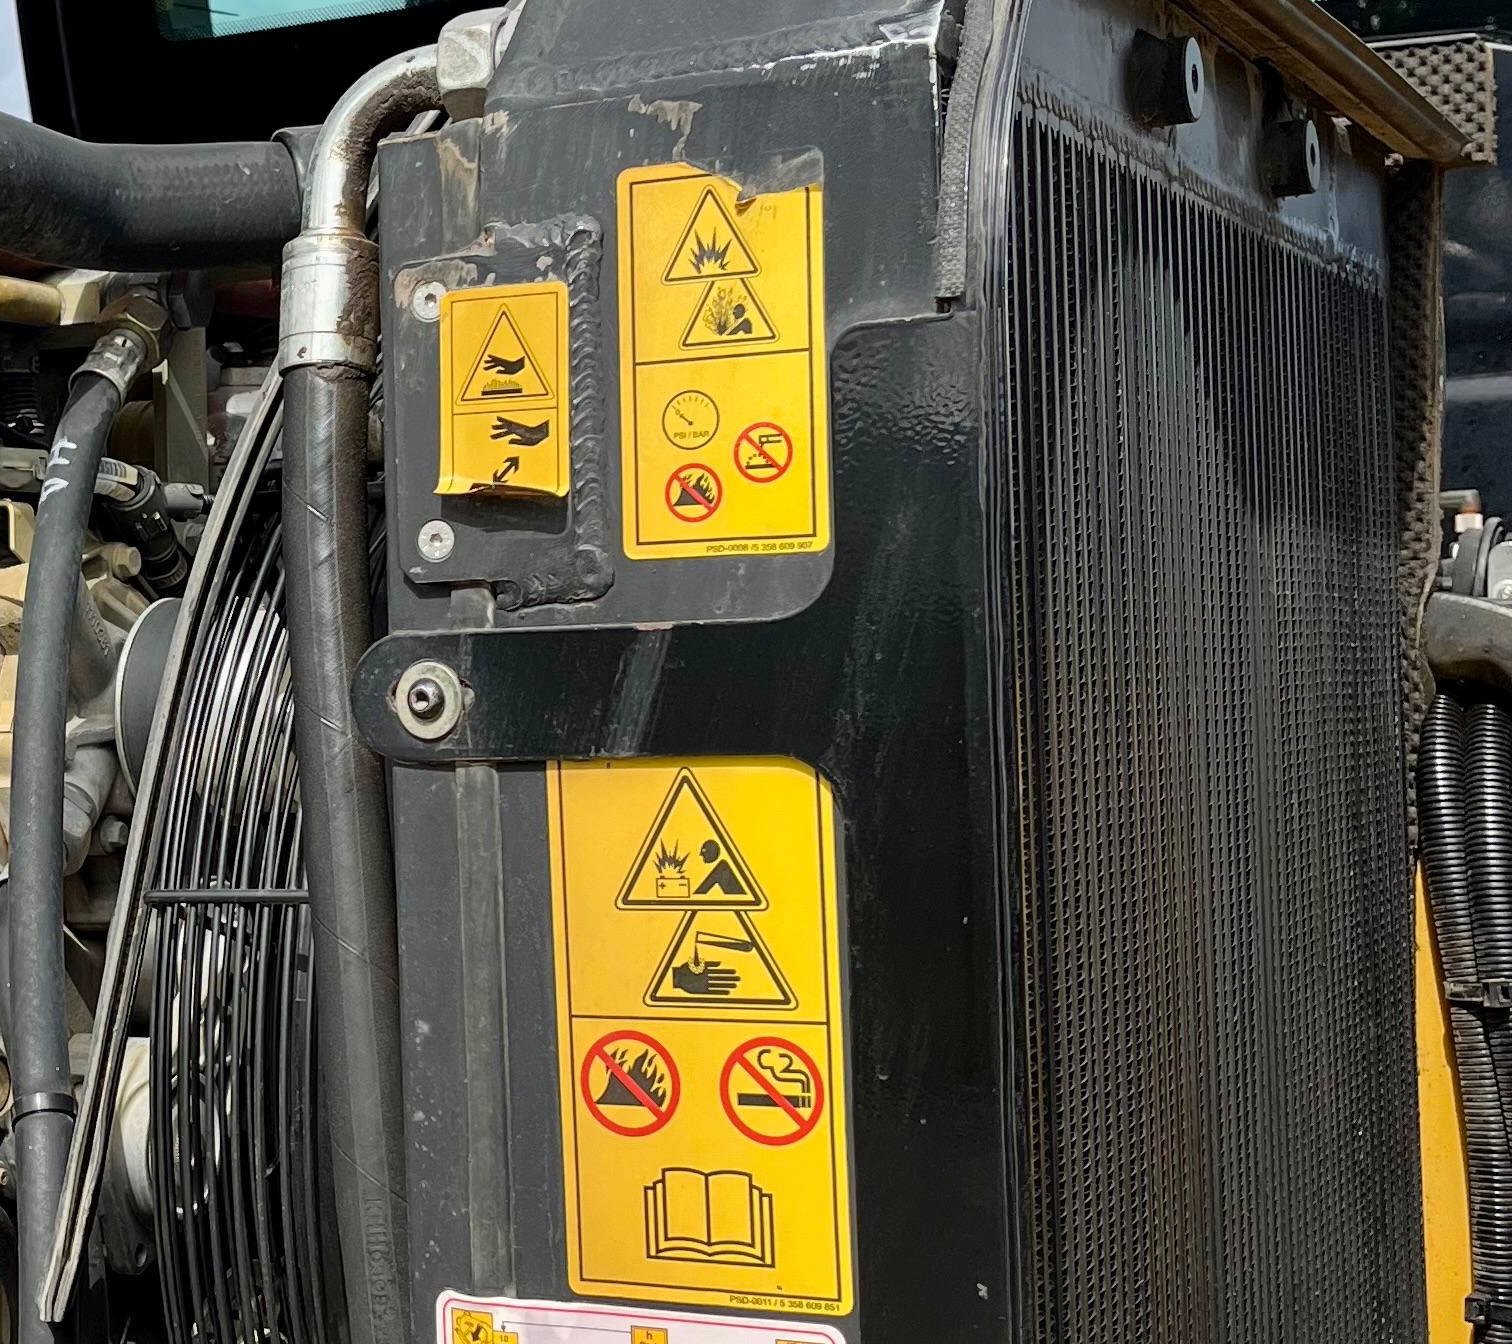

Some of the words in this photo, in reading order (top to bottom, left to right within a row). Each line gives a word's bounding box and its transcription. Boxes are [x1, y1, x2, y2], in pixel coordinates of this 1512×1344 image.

[692, 430, 710, 439] BAR
[761, 542, 777, 551] 358
[729, 1295, 772, 1307] PSD-0011
[779, 1299, 786, 1307] 5
[788, 1300, 804, 1309] 358
[806, 1301, 822, 1311] 609
[824, 1303, 841, 1312] 851
[646, 1330, 653, 1340] h
